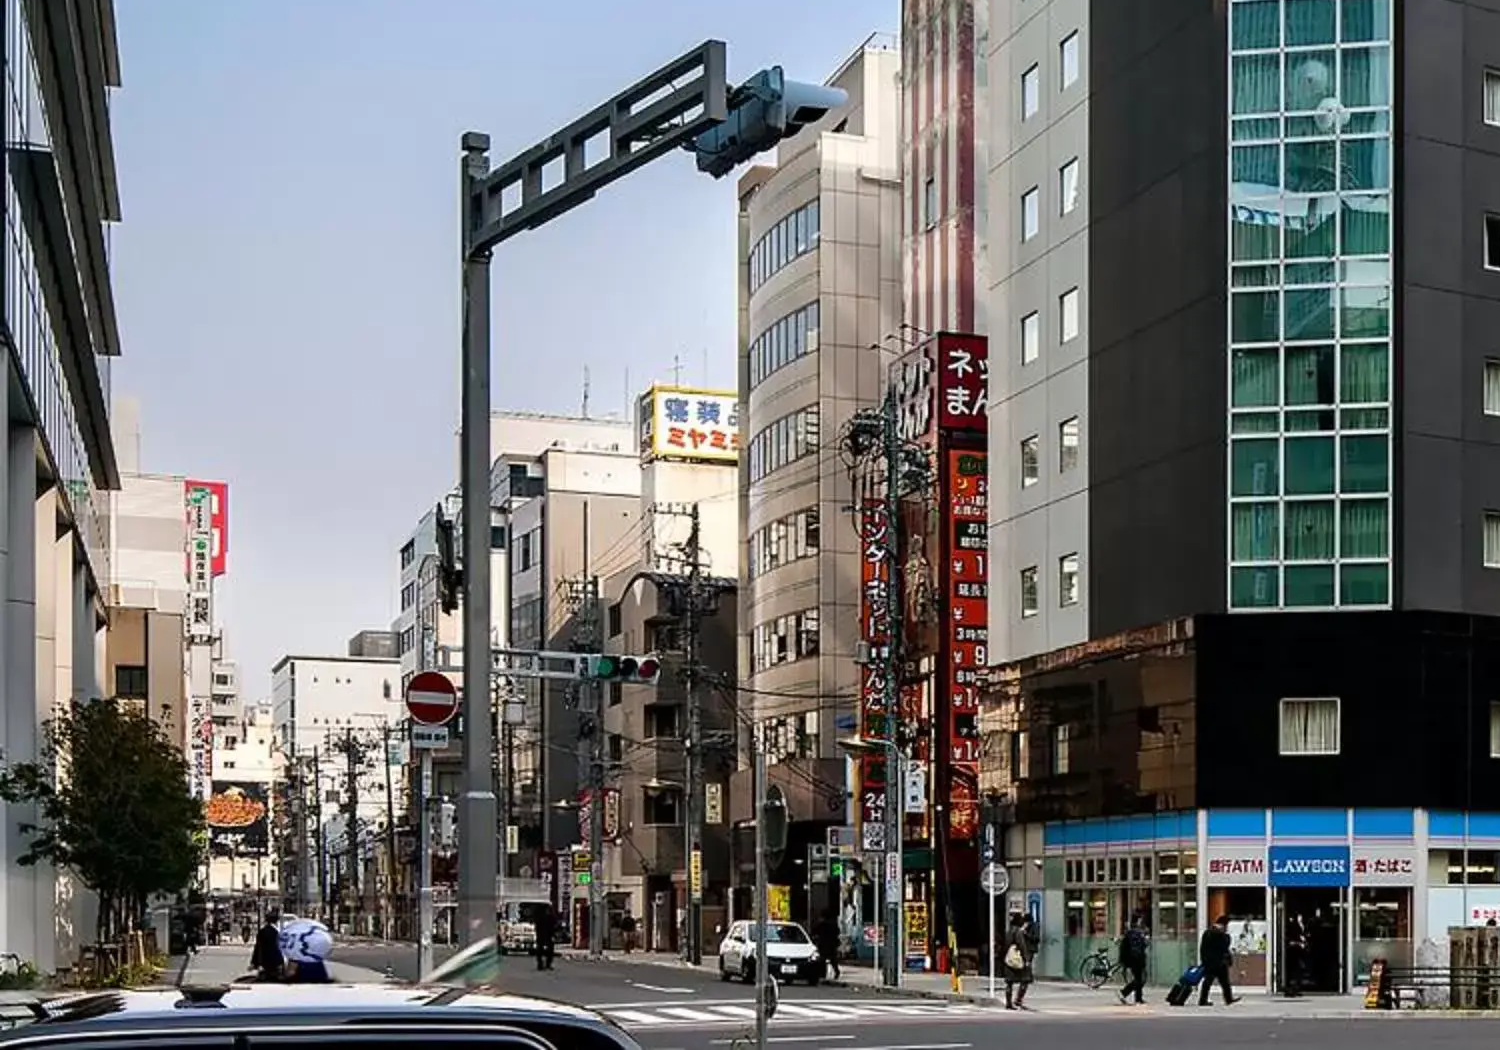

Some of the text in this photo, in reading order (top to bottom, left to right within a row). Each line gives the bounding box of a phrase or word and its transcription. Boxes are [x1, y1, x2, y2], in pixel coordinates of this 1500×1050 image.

[865, 793, 886, 808] 24
[871, 809, 881, 821] H
[1209, 859, 1264, 873] 銀行ATM
[1272, 859, 1346, 874] LAWSON
